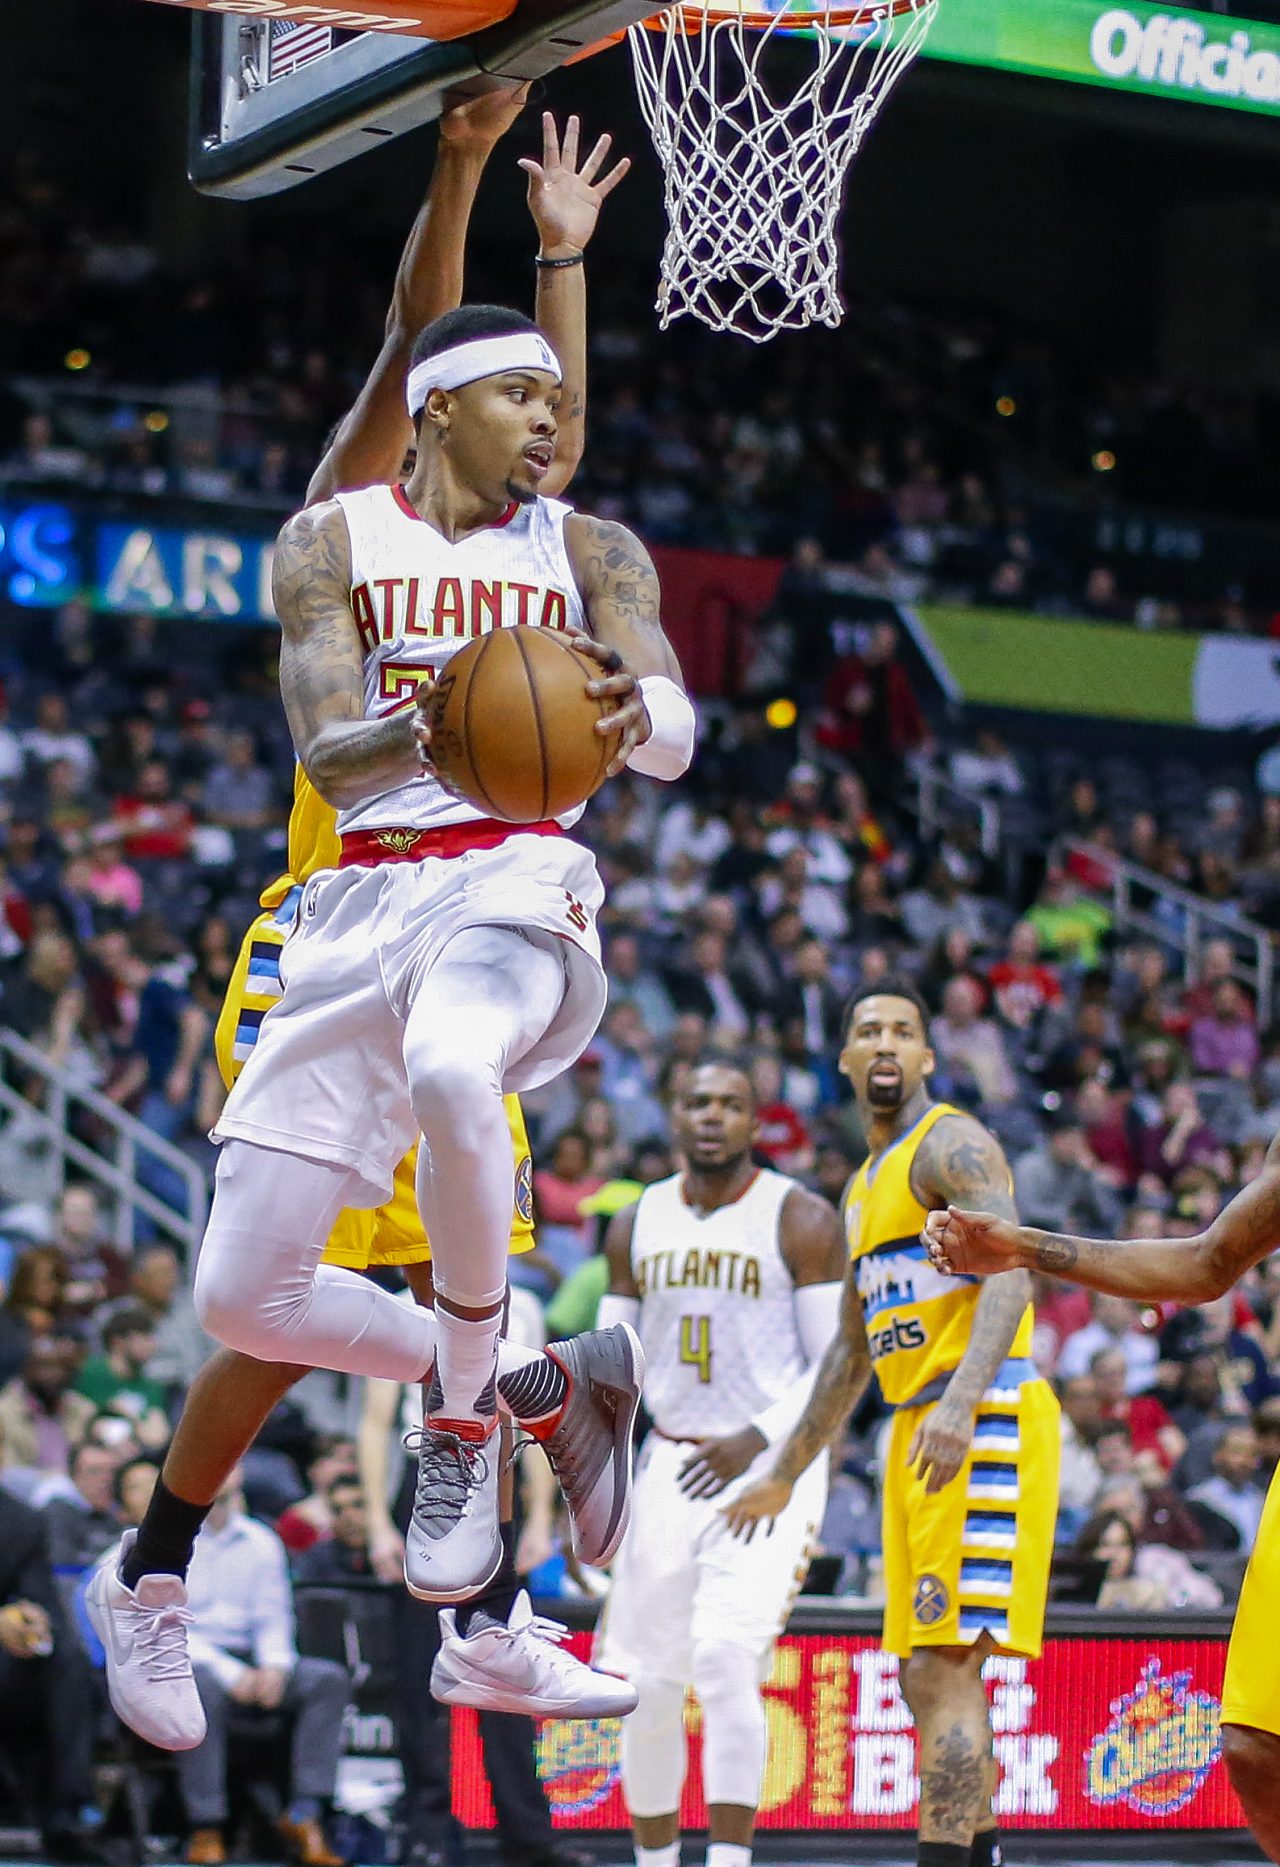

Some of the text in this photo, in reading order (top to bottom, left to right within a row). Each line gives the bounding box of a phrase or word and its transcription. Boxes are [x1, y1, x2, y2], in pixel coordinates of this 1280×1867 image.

[351, 576, 568, 653] ATLANTA
[634, 1246, 763, 1300] ATLANTA
[679, 1313, 713, 1384] 4
